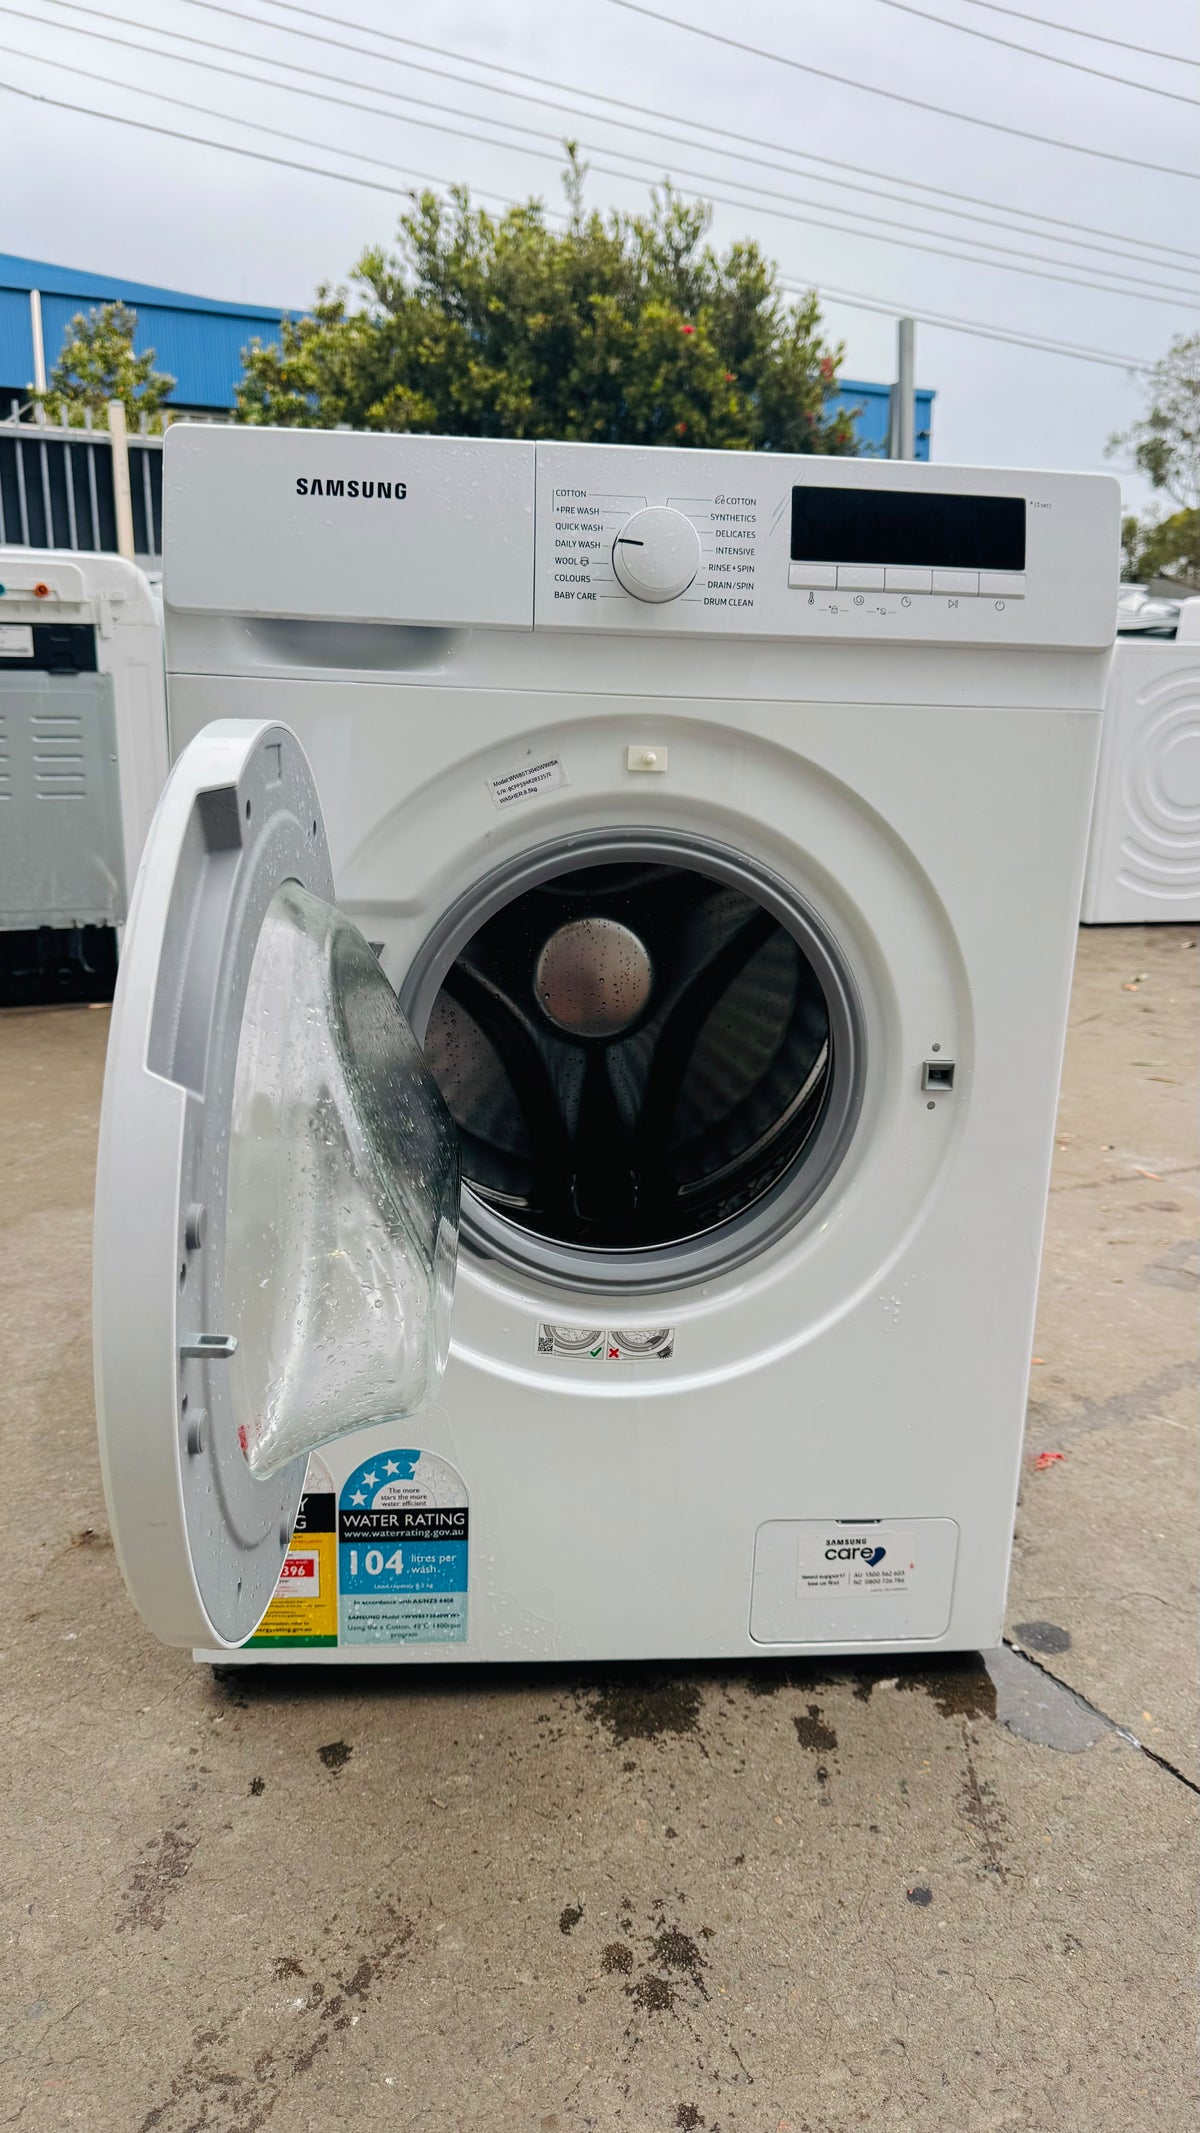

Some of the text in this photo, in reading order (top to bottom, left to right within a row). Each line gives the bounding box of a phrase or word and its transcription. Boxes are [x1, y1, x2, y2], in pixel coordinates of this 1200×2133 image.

[296, 477, 407, 500] SAMSUNG
[555, 489, 587, 498] COTTON
[710, 513, 756, 523] SYNTHETICS
[555, 523, 604, 532] QUICK WASH
[715, 530, 756, 539] DELICATES
[555, 540, 601, 549] DAILY WASH
[715, 547, 755, 556] INTENSIVE
[555, 557, 578, 565] WOOL
[554, 574, 591, 583] COLOURS
[554, 591, 597, 600] BABY CARE
[703, 598, 754, 607] DRUM CLEAN
[343, 1513, 465, 1527] WATER RATING
[344, 1528, 464, 1539] www.waterrating.gov.au
[825, 1538, 867, 1546] SAMSUNG
[825, 1547, 873, 1560] care
[350, 1549, 404, 1575] 104
[411, 1554, 456, 1564] litres per
[282, 1565, 306, 1576] 396
